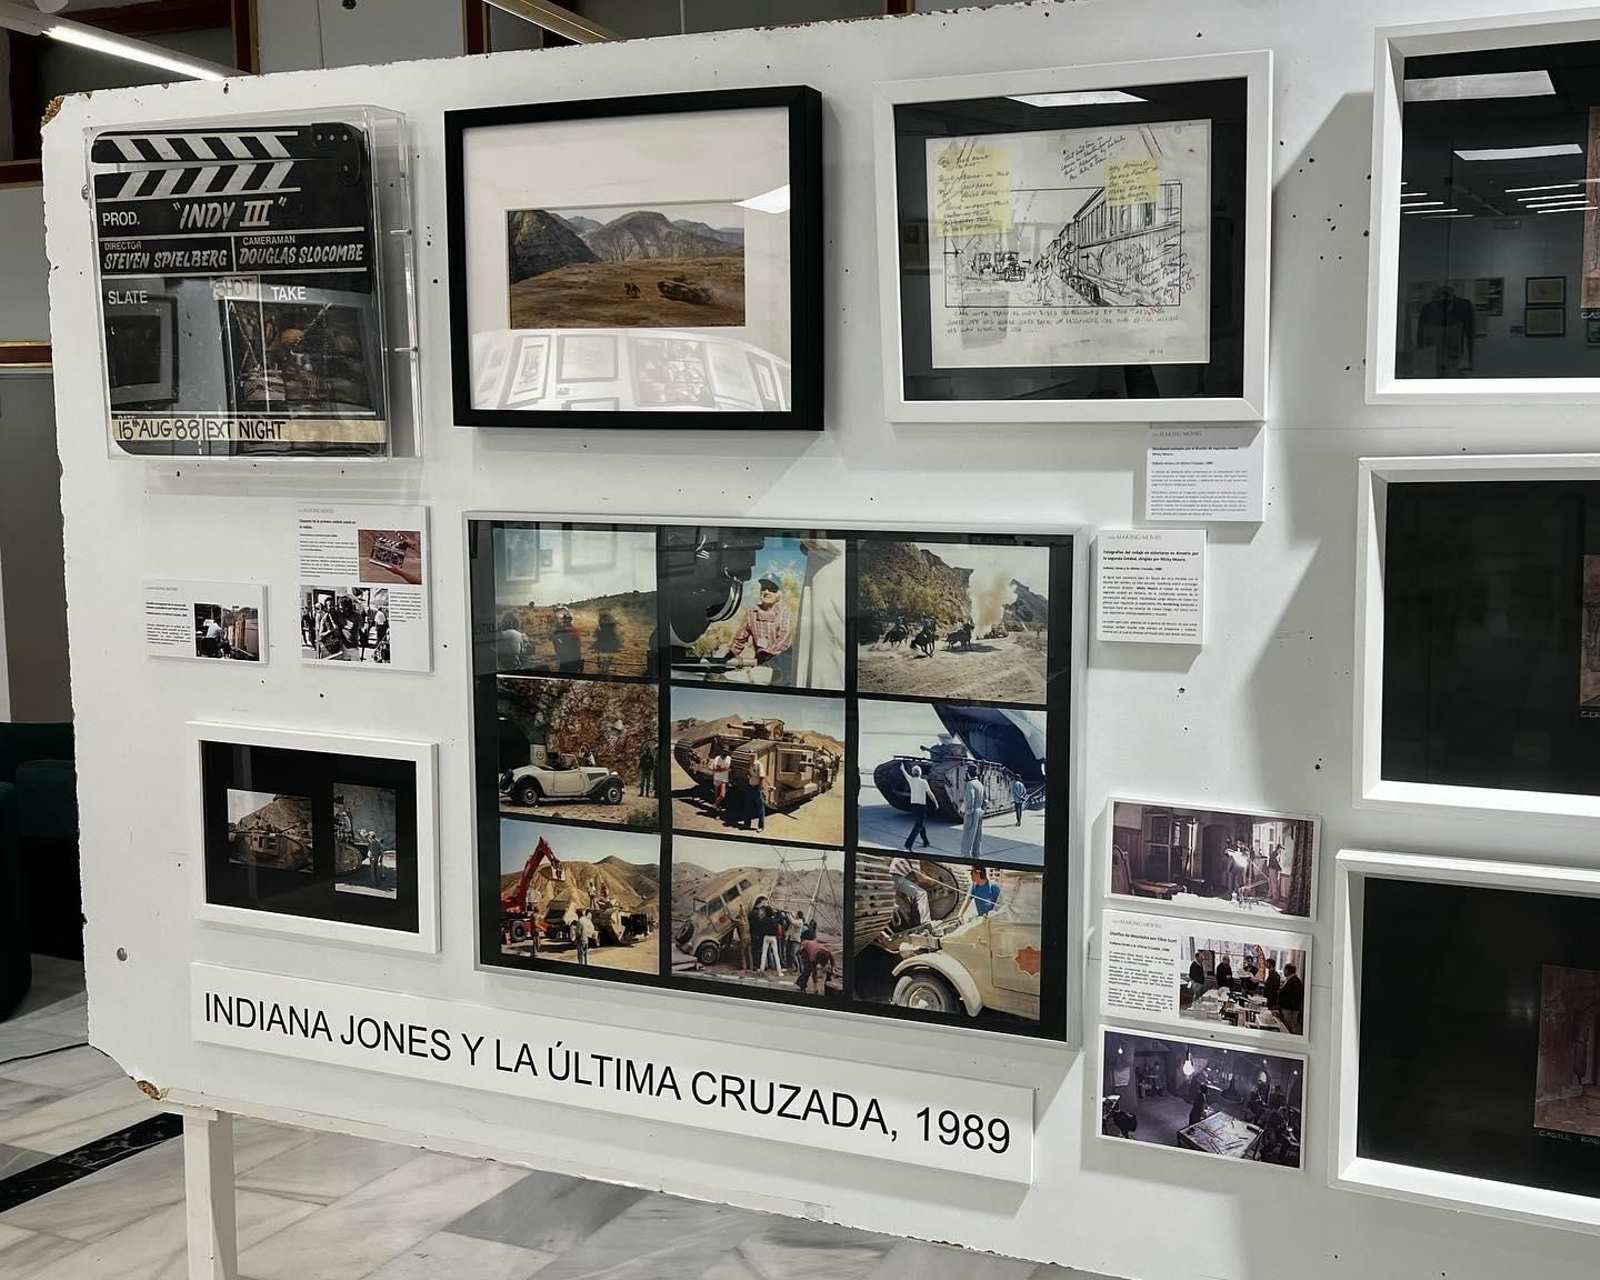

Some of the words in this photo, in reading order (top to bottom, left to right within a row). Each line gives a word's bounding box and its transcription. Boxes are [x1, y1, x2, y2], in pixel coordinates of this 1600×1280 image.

[102, 211, 140, 228] PROD.
[104, 241, 142, 251] DIRECTOR
[242, 236, 296, 246] CAMERAMAN
[104, 252, 150, 270] STEVEN
[154, 248, 228, 268] SPIELBERG
[239, 248, 296, 264] DOUGLAS
[298, 244, 364, 264] SLOCOMBE
[108, 290, 148, 305] SLATE
[271, 286, 306, 300] TAKE
[140, 420, 172, 438] AUG
[174, 419, 200, 439] 88
[206, 421, 234, 438] EXT
[239, 420, 286, 439] NIGHT
[205, 992, 332, 1042] INDIANA
[340, 1015, 452, 1062] JONES
[461, 1032, 484, 1066] Y
[494, 1039, 538, 1076] LA
[547, 1041, 682, 1100] ÚLTIMA
[691, 1070, 898, 1141] CRUZADA,
[916, 1106, 1011, 1154] 1989
